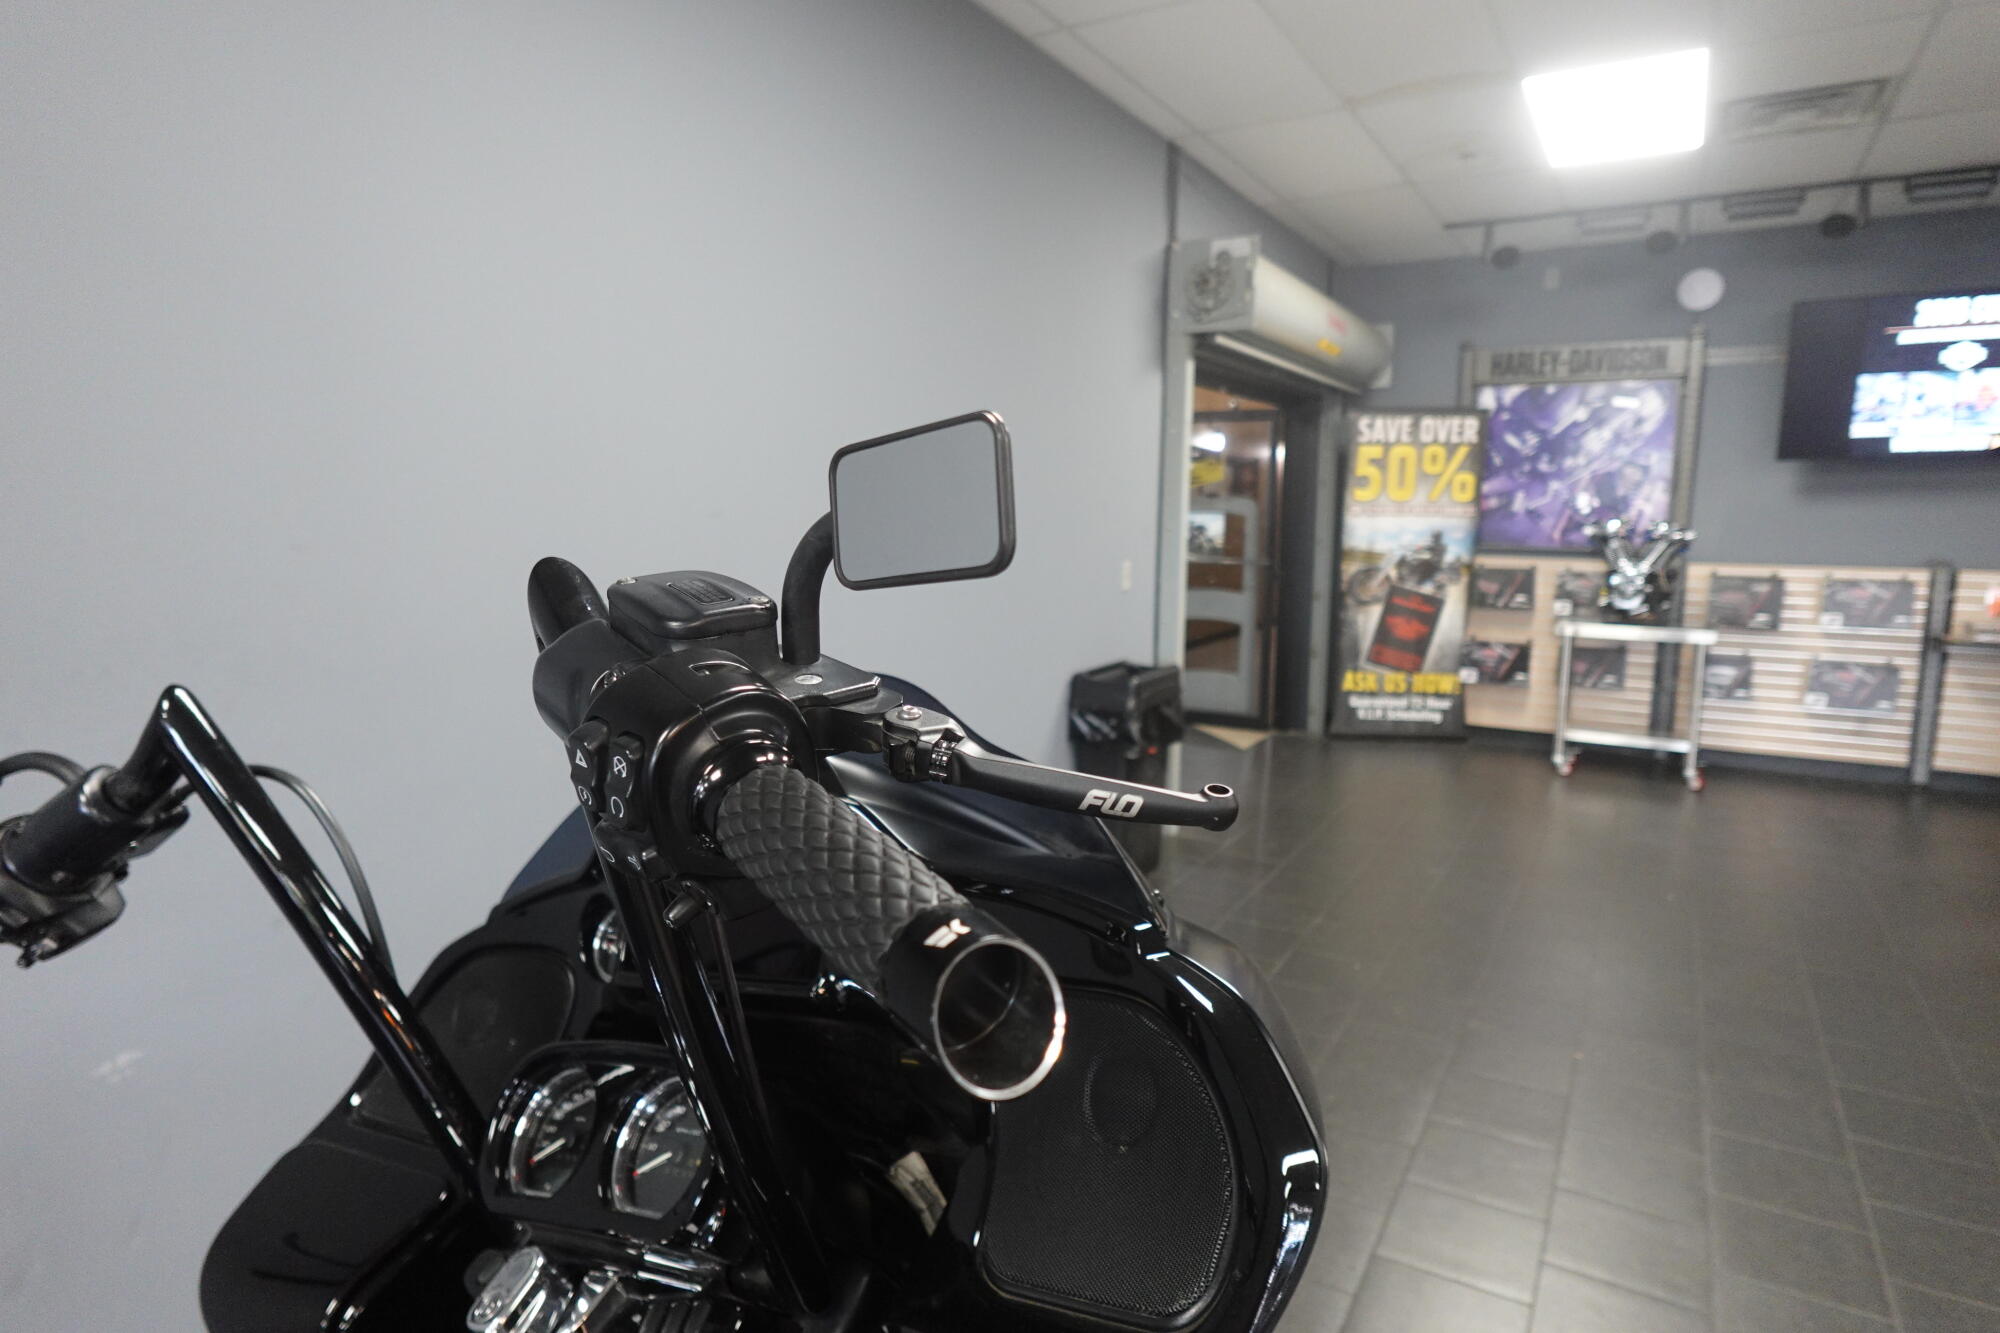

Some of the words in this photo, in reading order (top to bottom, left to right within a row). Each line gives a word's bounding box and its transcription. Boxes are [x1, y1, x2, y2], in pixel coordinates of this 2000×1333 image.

[1490, 346, 1669, 377] HARLEY-DAVIDSON
[1358, 416, 1413, 444] SAVE
[1419, 415, 1480, 444] OVER
[1352, 444, 1477, 503] 50%
[1343, 670, 1378, 692] ASK
[1383, 671, 1407, 693] US
[1079, 789, 1144, 818] FLO
